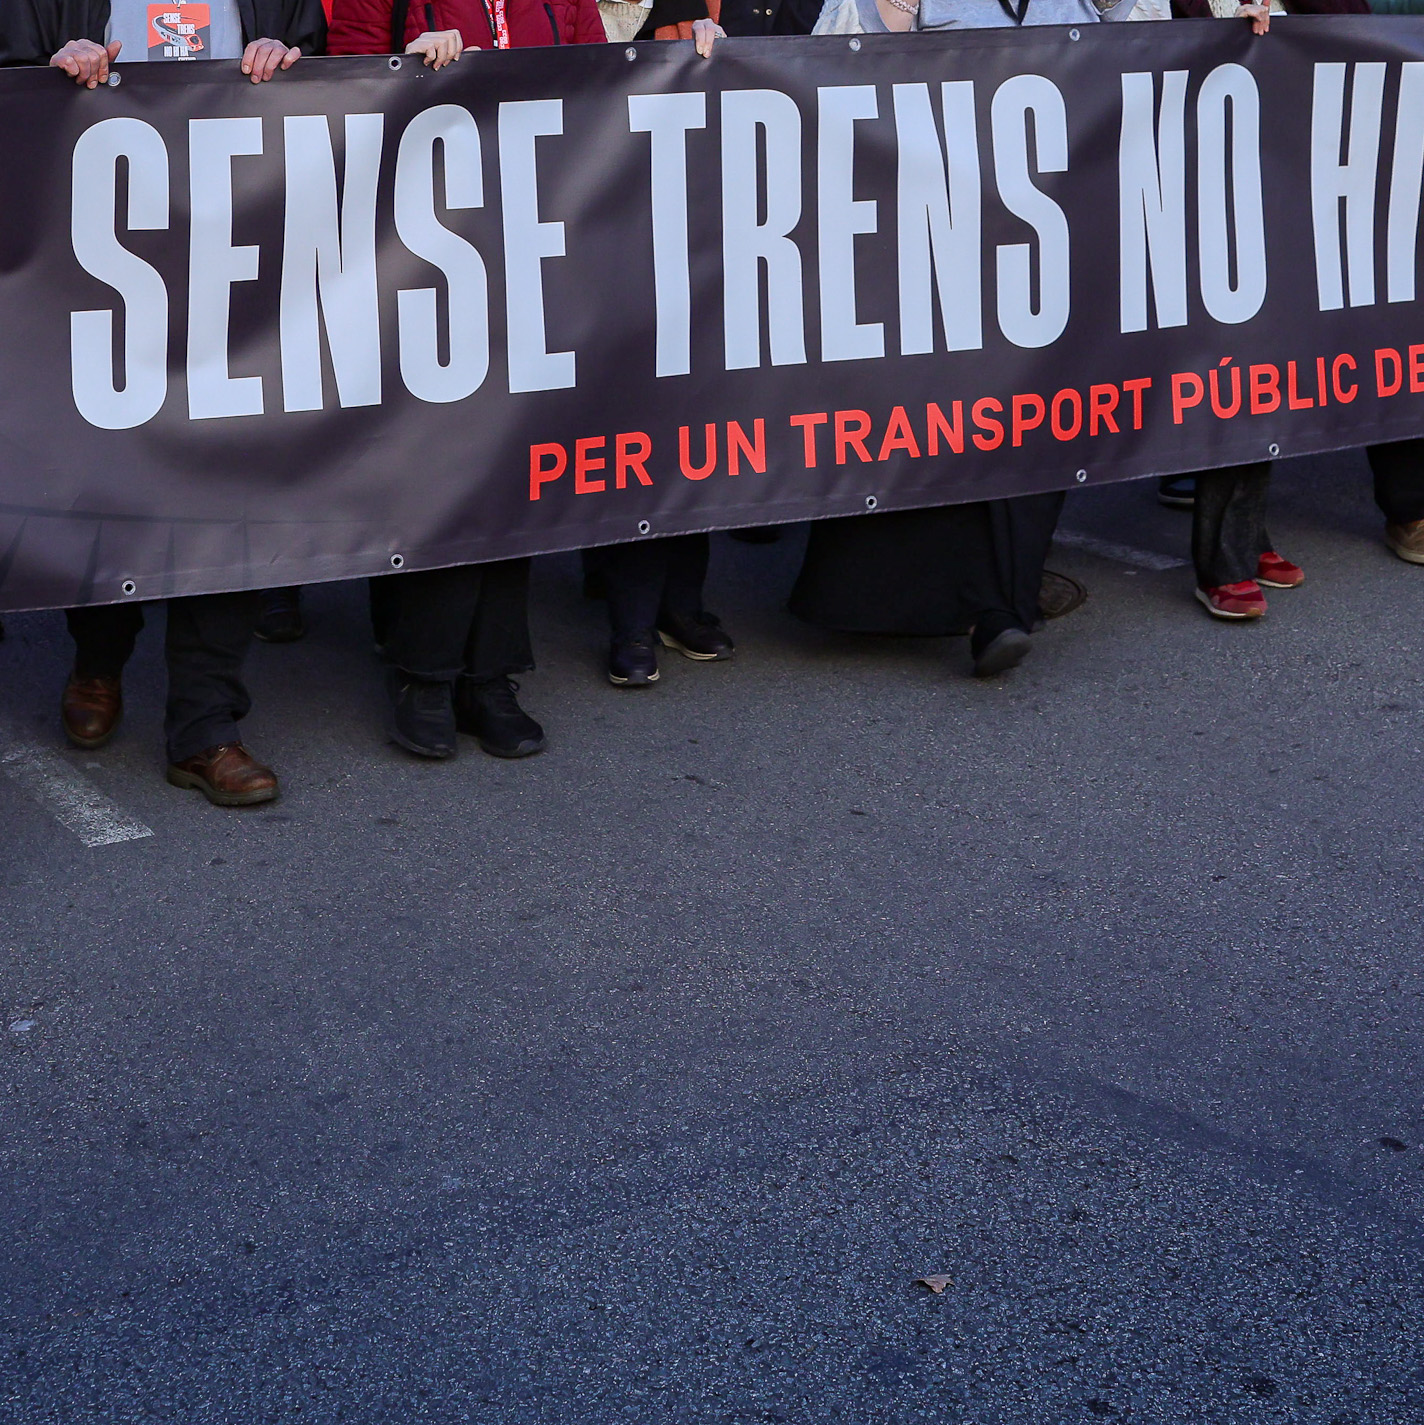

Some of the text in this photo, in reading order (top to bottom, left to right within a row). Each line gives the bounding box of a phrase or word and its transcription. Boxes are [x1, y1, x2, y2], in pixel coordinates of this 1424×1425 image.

[71, 99, 576, 429] SENSE
[628, 74, 1070, 377] TRENS
[1119, 63, 1267, 334] NO
[529, 431, 654, 501] PER
[678, 418, 766, 481] UN
[790, 378, 1152, 469] TRANSPORT
[1171, 354, 1359, 425] PÚBLIC
